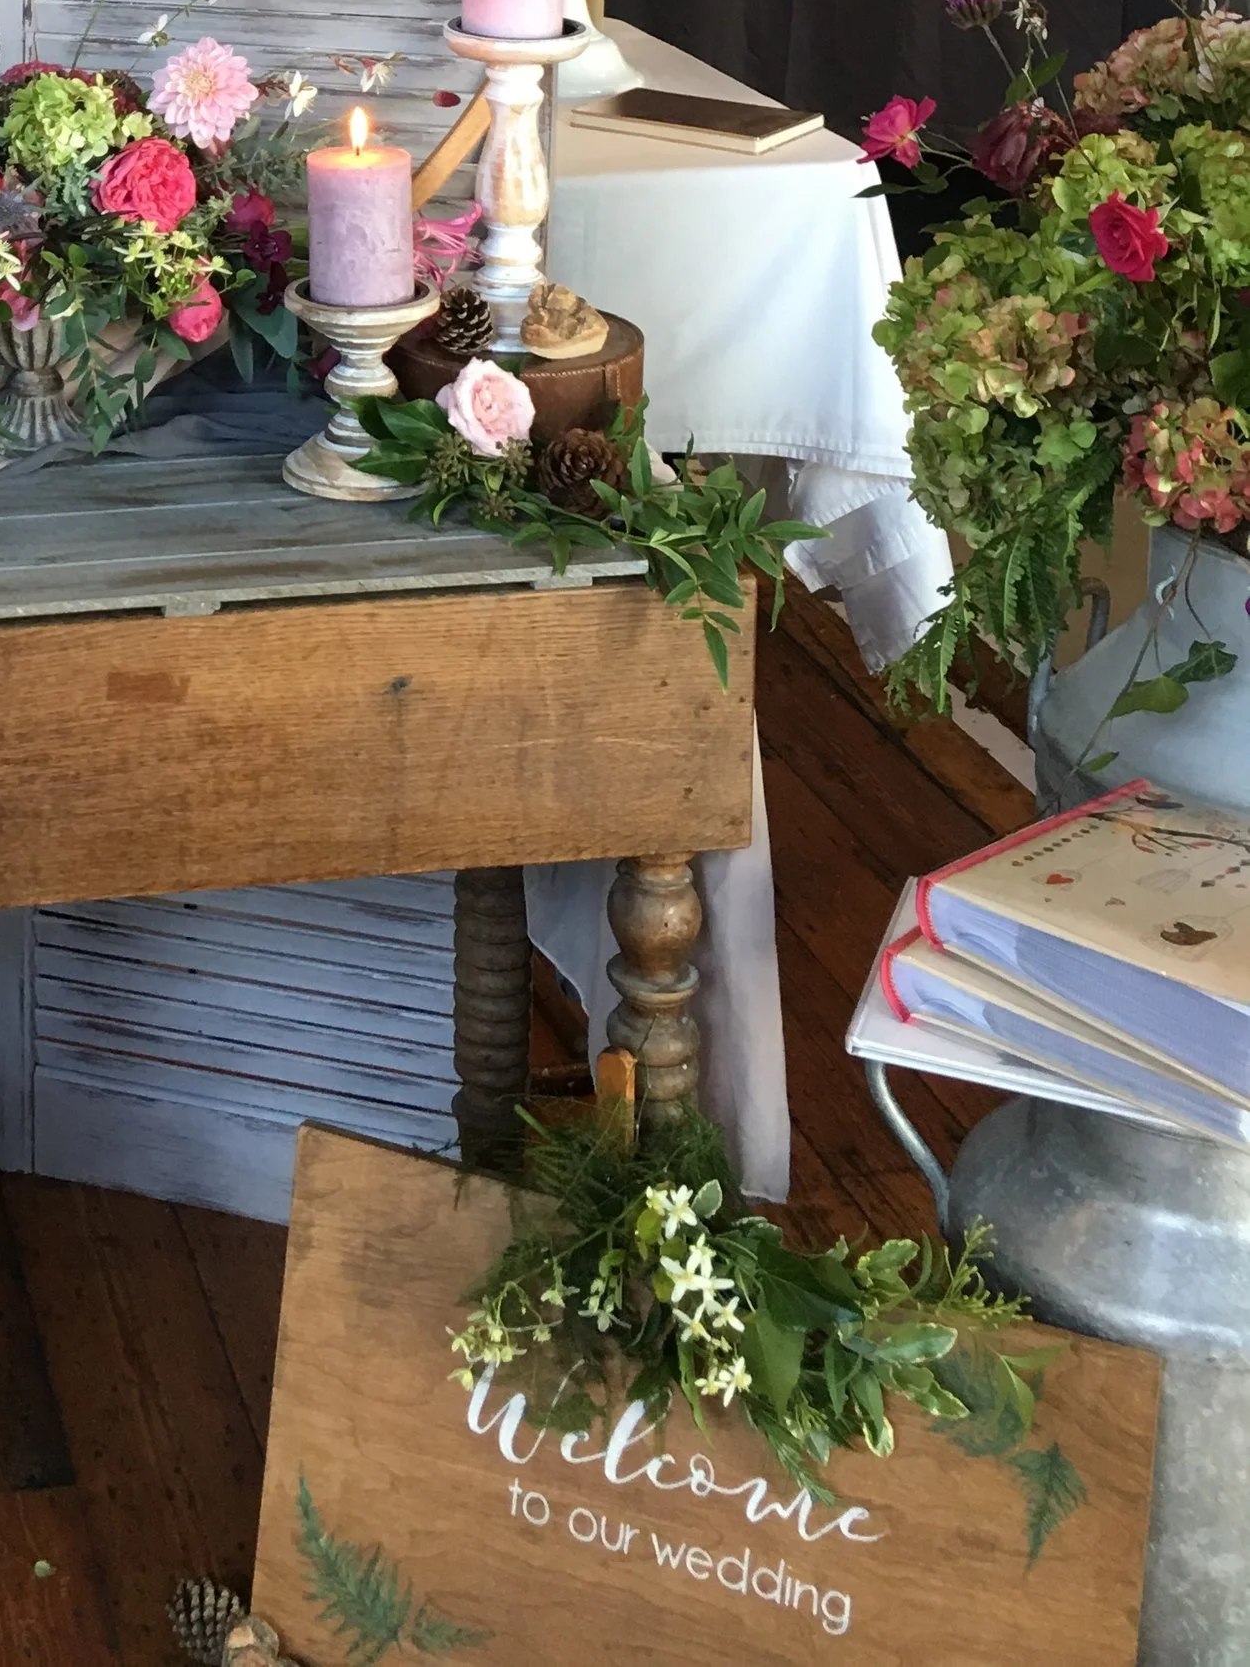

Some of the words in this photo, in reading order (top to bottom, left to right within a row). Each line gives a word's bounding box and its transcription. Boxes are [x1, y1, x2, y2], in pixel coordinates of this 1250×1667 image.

[466, 1358, 886, 1542] Welcome
[508, 1478, 550, 1526] to
[568, 1507, 640, 1554] our
[651, 1533, 851, 1635] wedding
